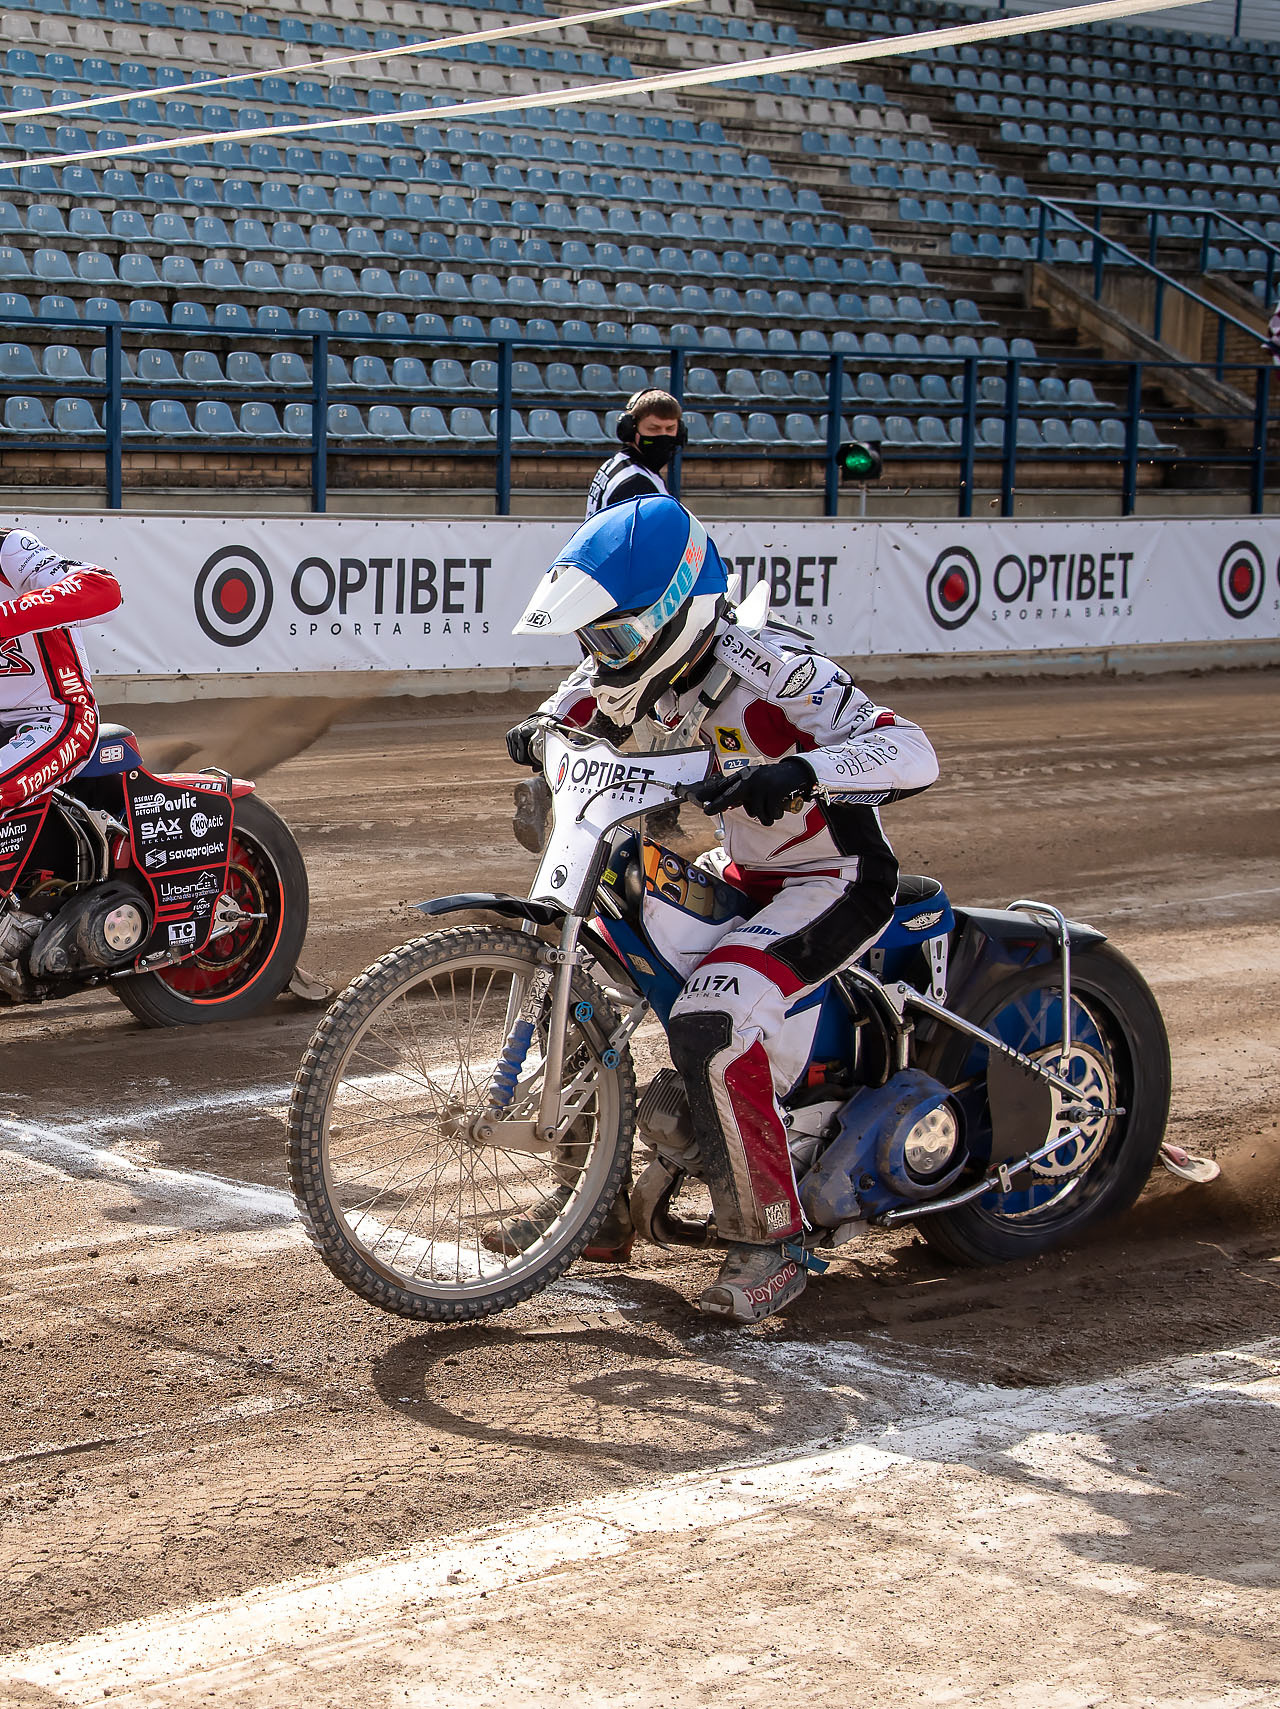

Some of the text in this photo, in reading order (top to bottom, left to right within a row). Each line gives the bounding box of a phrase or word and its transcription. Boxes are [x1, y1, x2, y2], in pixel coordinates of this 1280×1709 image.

[55, 575, 83, 597] MF
[290, 556, 492, 616] OPTIBET
[721, 556, 838, 607] TIBET
[993, 552, 1134, 604] OPTIBET
[991, 603, 1133, 621] SPORTA BĀRS
[289, 619, 490, 636] SPORTA BĀRS
[722, 634, 772, 678] SOFIA
[58, 666, 83, 695] MF
[101, 746, 123, 763] 98
[17, 738, 81, 798] Trans MF
[571, 758, 655, 795] OPTIBET
[611, 792, 644, 804] BĀRS
[0, 843, 20, 855] AVTO
[141, 834, 184, 845] REKLAME
[168, 841, 225, 860] savaprojekt
[171, 924, 194, 939] TC
